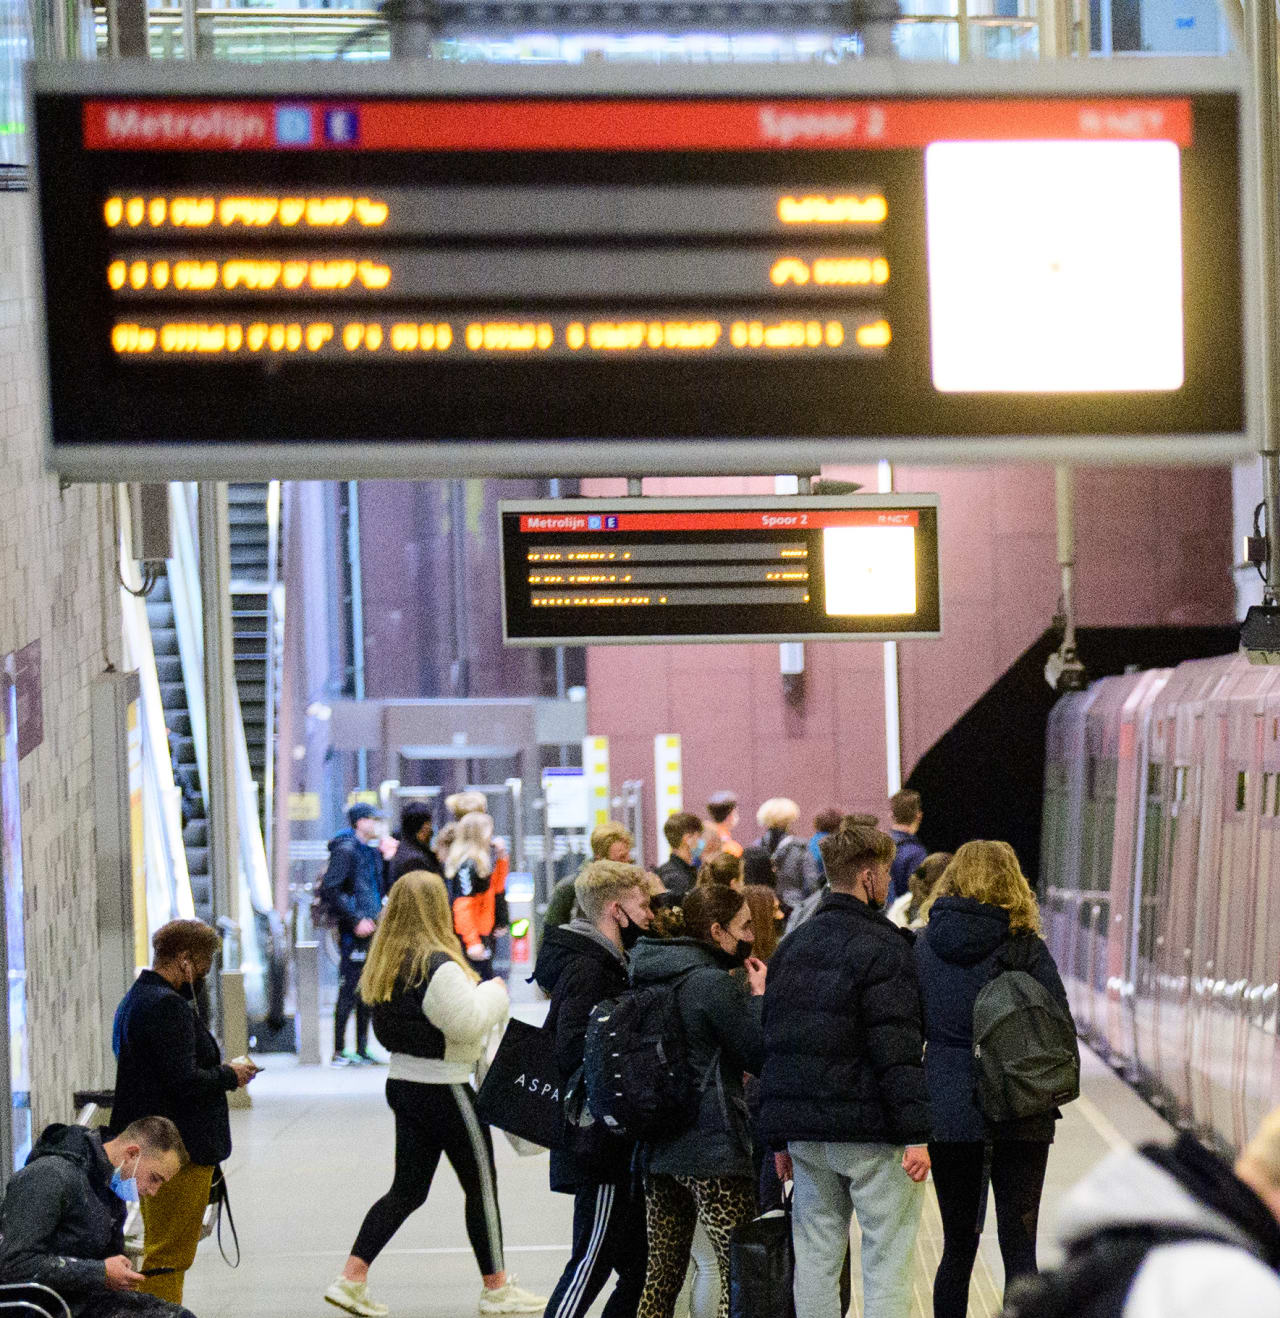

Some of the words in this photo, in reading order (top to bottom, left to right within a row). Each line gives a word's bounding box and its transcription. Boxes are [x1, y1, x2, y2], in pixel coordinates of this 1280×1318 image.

[527, 517, 585, 530] Metrolijn
[607, 517, 615, 528] E
[761, 514, 797, 527] Spoor
[800, 514, 808, 525] 2
